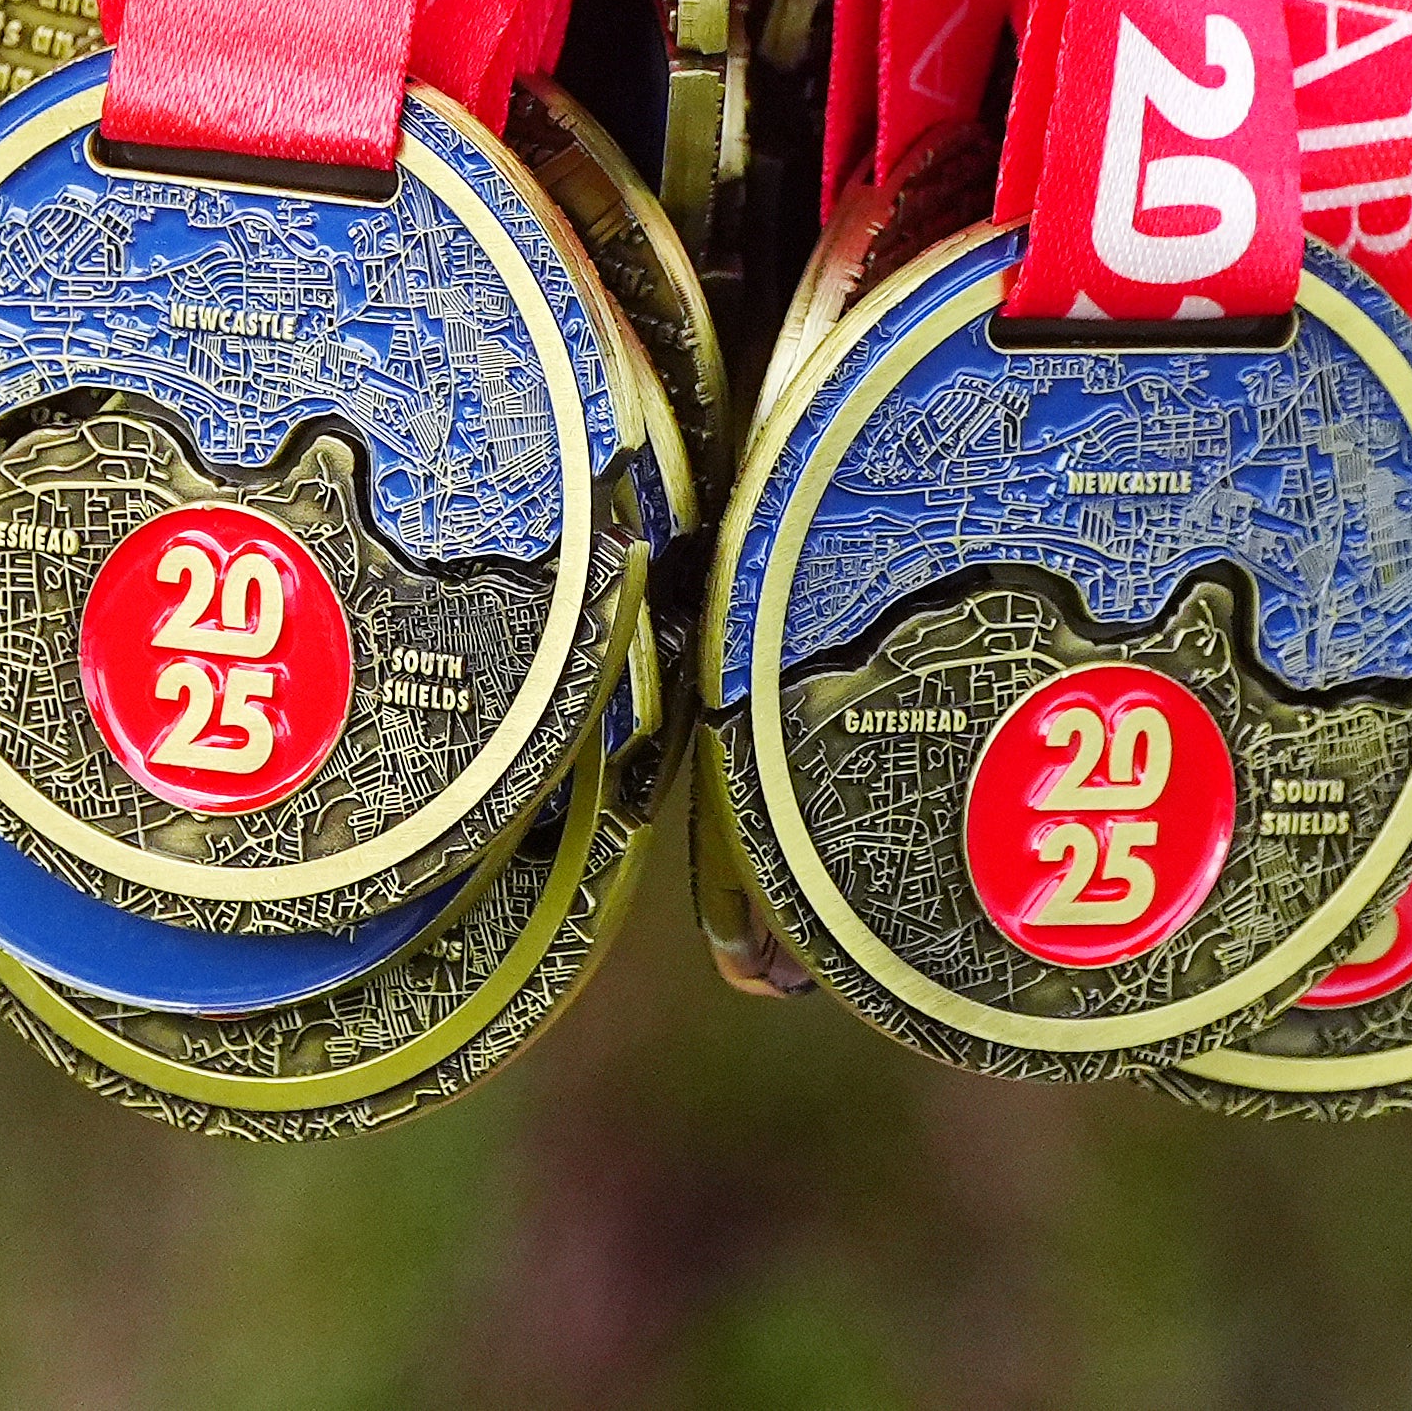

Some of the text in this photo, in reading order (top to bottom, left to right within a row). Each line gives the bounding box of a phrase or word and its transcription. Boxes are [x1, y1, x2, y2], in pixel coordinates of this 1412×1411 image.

[169, 300, 299, 342] NEWCASTLE
[1065, 469, 1193, 495] NEWCASTLE
[150, 544, 285, 659] 20
[390, 646, 464, 680] SOUTH
[381, 677, 471, 714] SHIELDS
[148, 661, 275, 775] 25
[844, 708, 969, 734] GATESHEAD
[1034, 706, 1173, 812] 20
[1270, 778, 1346, 804] SOUTH
[1259, 810, 1351, 836] SHIELDS
[1028, 821, 1160, 927] 25
